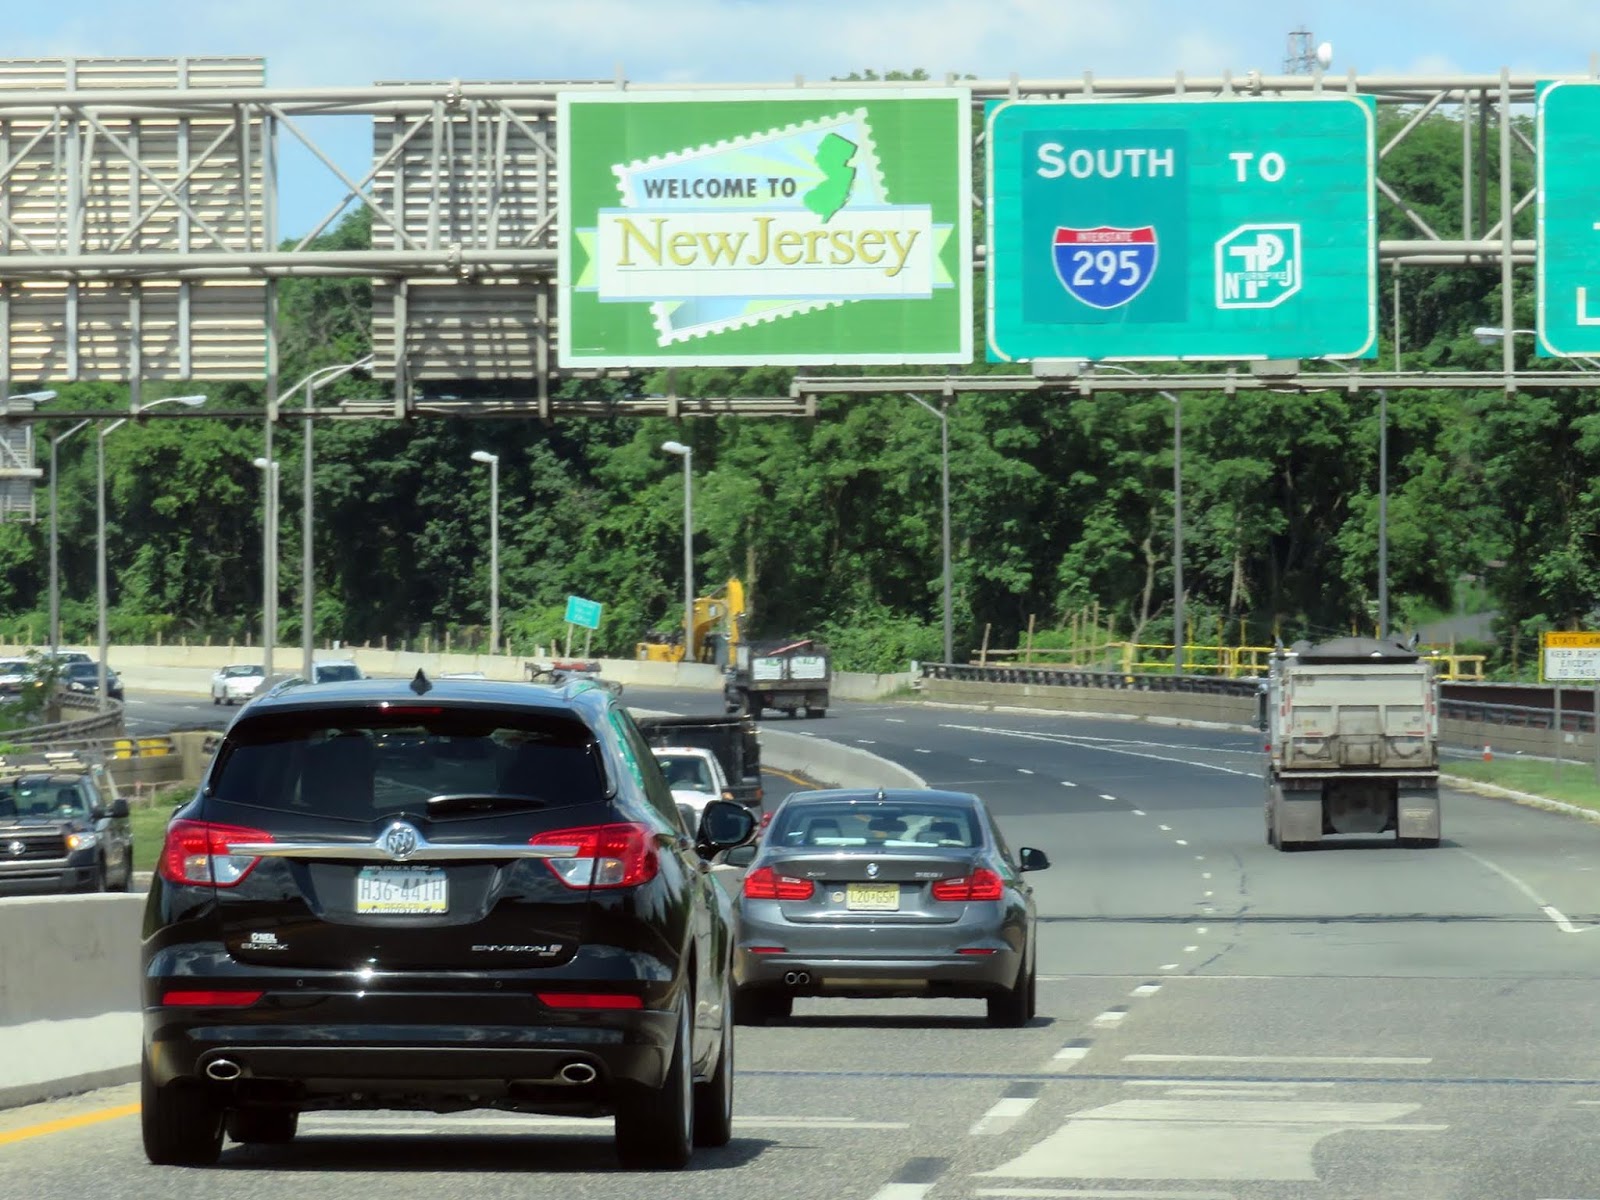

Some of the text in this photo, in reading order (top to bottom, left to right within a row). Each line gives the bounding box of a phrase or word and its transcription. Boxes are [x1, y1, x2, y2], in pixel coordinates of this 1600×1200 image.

[1036, 142, 1174, 178] SOUTH
[1228, 152, 1287, 182] TO
[643, 177, 797, 199] WELCOME TO
[1076, 231, 1134, 242] INTERSTATE
[1072, 249, 1141, 286] 295
[471, 944, 547, 952] ENVISION
